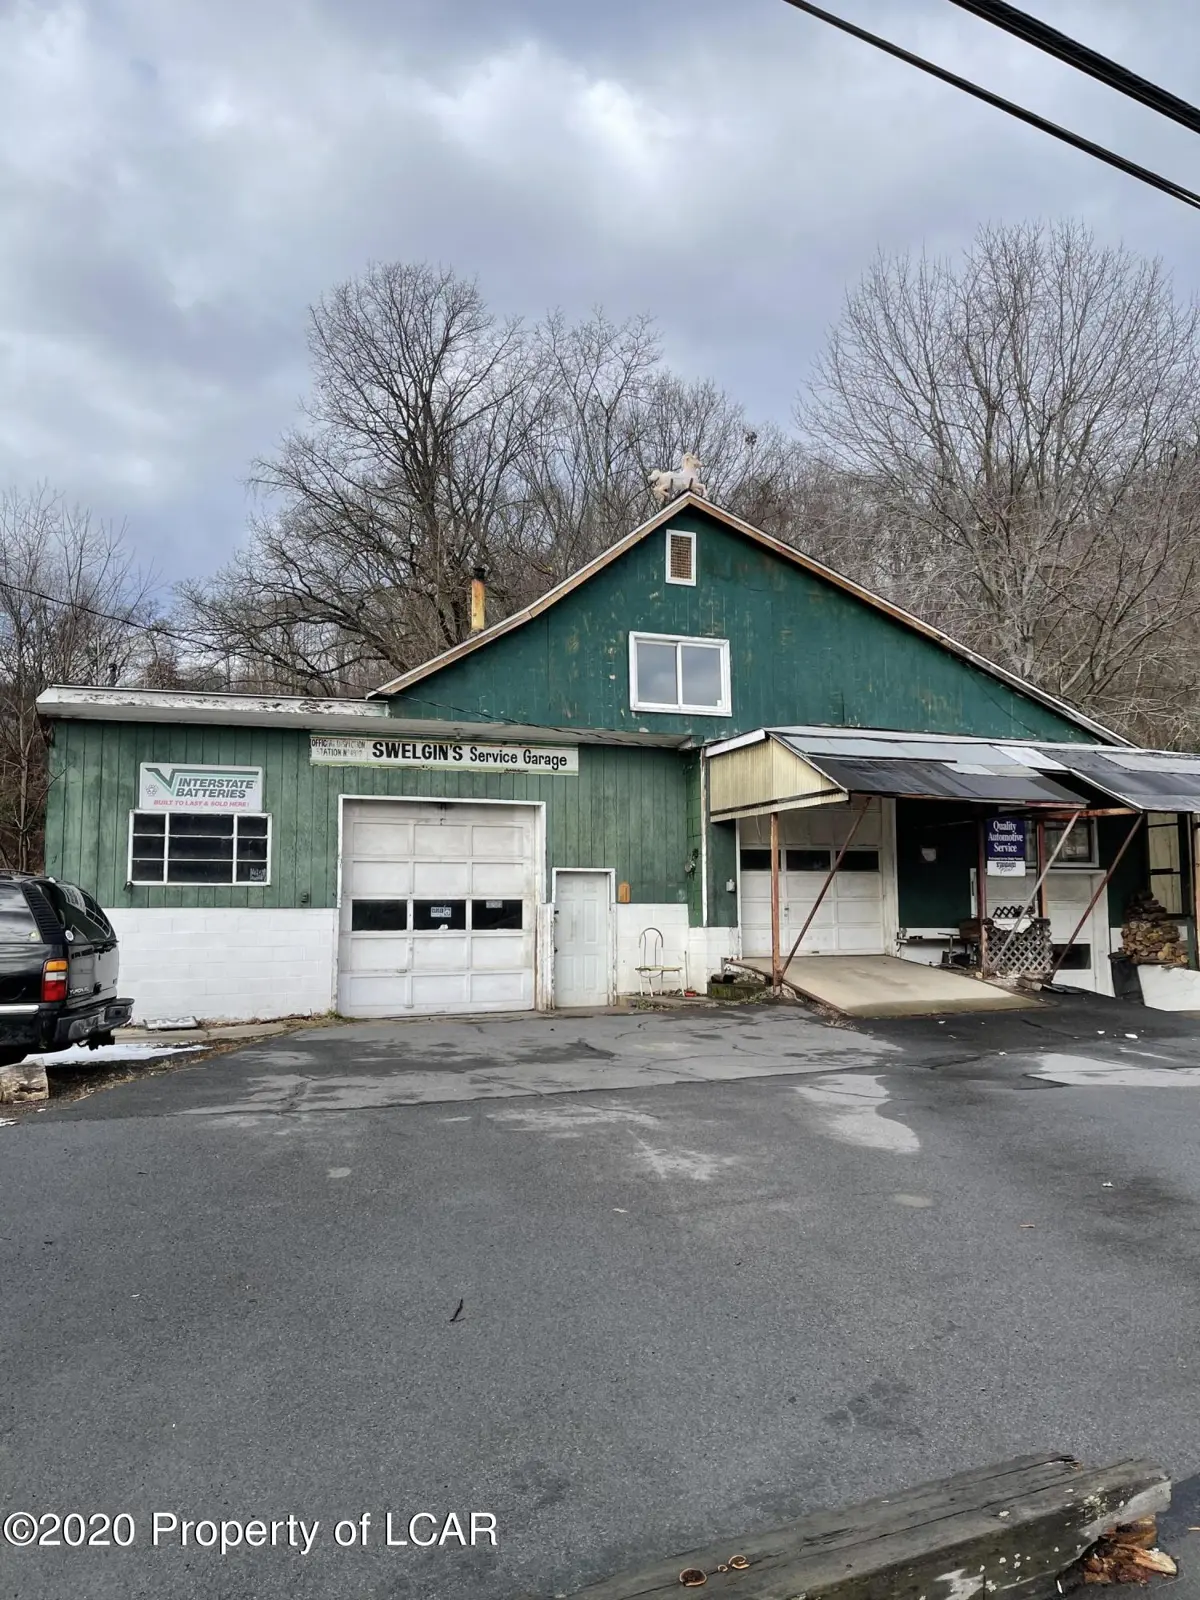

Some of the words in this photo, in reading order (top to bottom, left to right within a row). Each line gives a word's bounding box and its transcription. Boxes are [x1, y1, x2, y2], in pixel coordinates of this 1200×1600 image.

[372, 741, 464, 762] SWELGIN'S
[470, 746, 518, 764] Service
[523, 750, 568, 770] Garage
[178, 778, 254, 789] INTERSTATE
[176, 788, 246, 798] BATTERIES
[993, 820, 1017, 833] Quality
[988, 832, 1024, 842] Automotive
[994, 842, 1018, 853] Service
